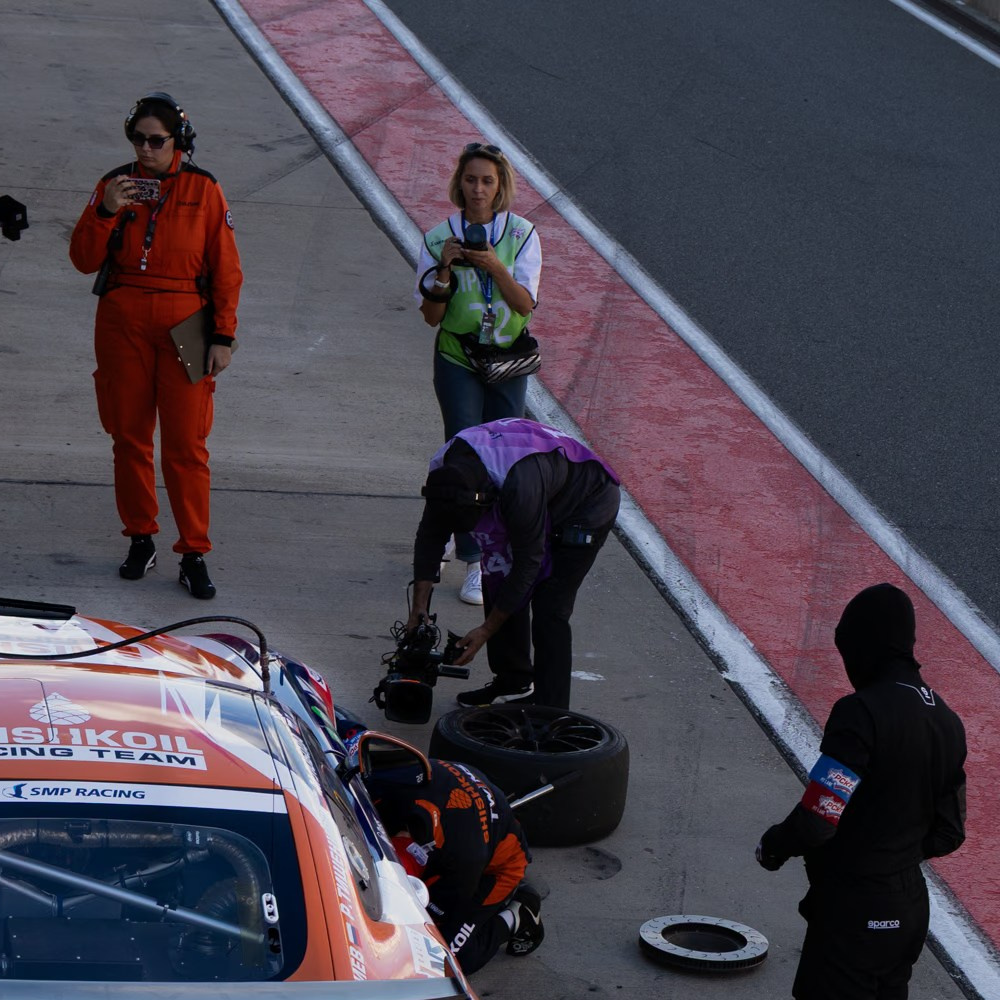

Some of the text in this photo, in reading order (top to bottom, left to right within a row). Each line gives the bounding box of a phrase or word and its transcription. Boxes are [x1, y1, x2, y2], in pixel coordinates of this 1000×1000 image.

[90, 748, 197, 767] TEAM
[30, 786, 146, 800] SMP RACING
